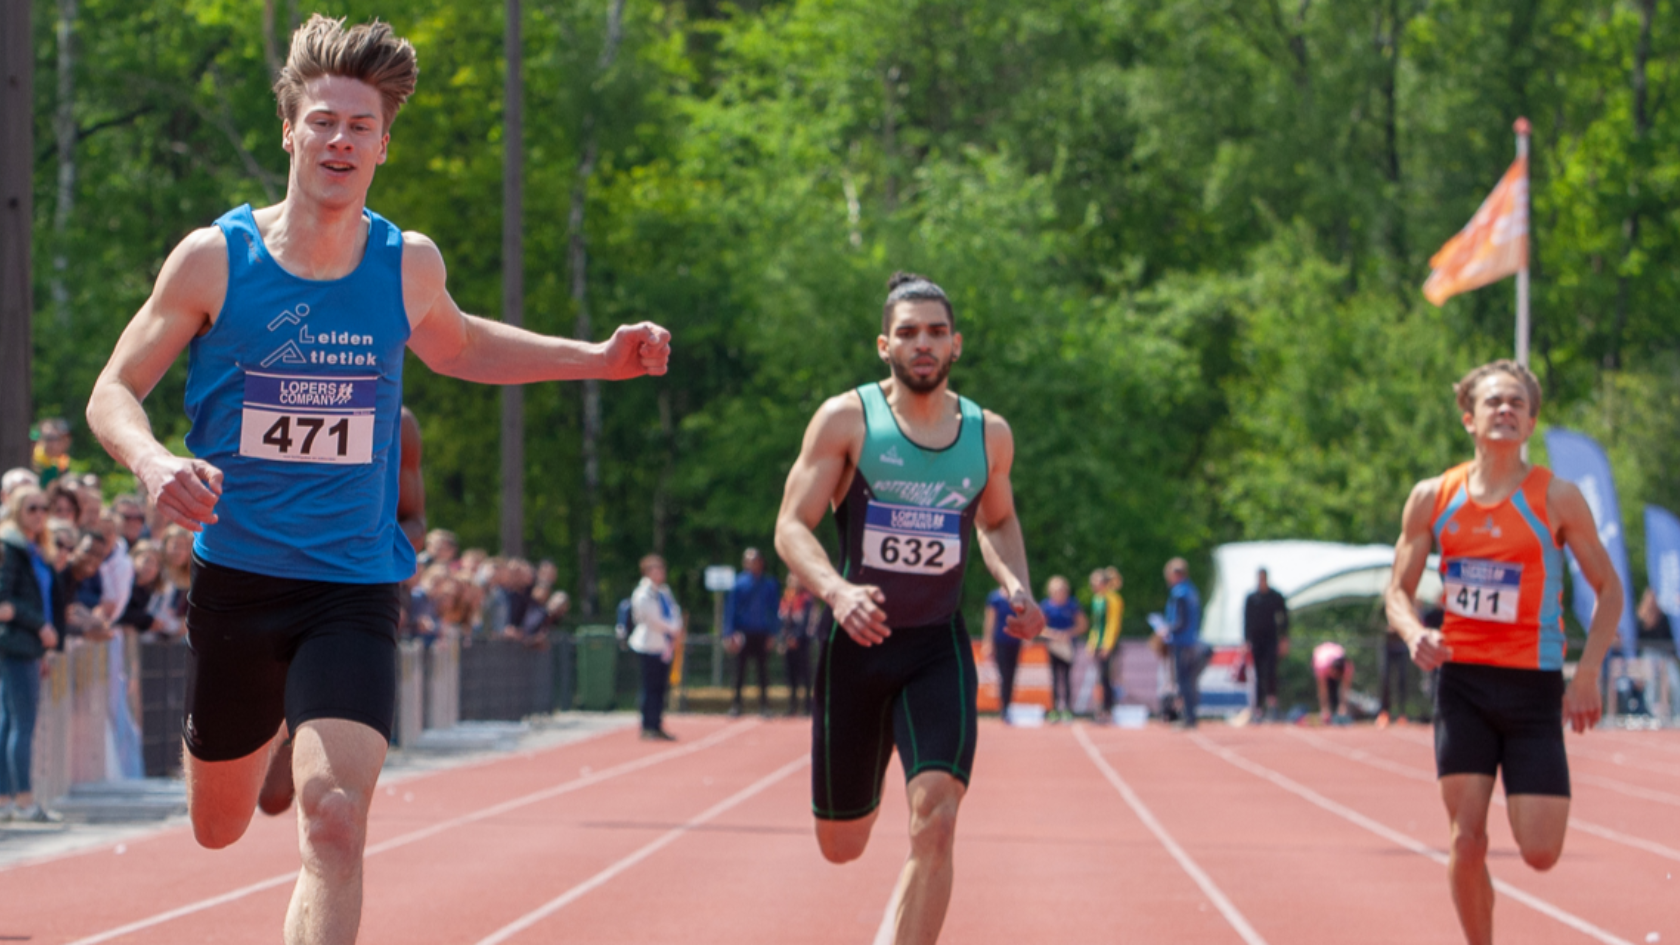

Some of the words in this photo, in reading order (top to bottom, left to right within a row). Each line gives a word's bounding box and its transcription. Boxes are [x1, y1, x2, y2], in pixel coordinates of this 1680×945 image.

[299, 324, 374, 345] Leiden
[280, 381, 337, 397] LOPERS
[280, 390, 336, 406] COMPANY
[262, 416, 349, 456] 471
[880, 536, 945, 567] 632
[1457, 587, 1499, 614] 411
